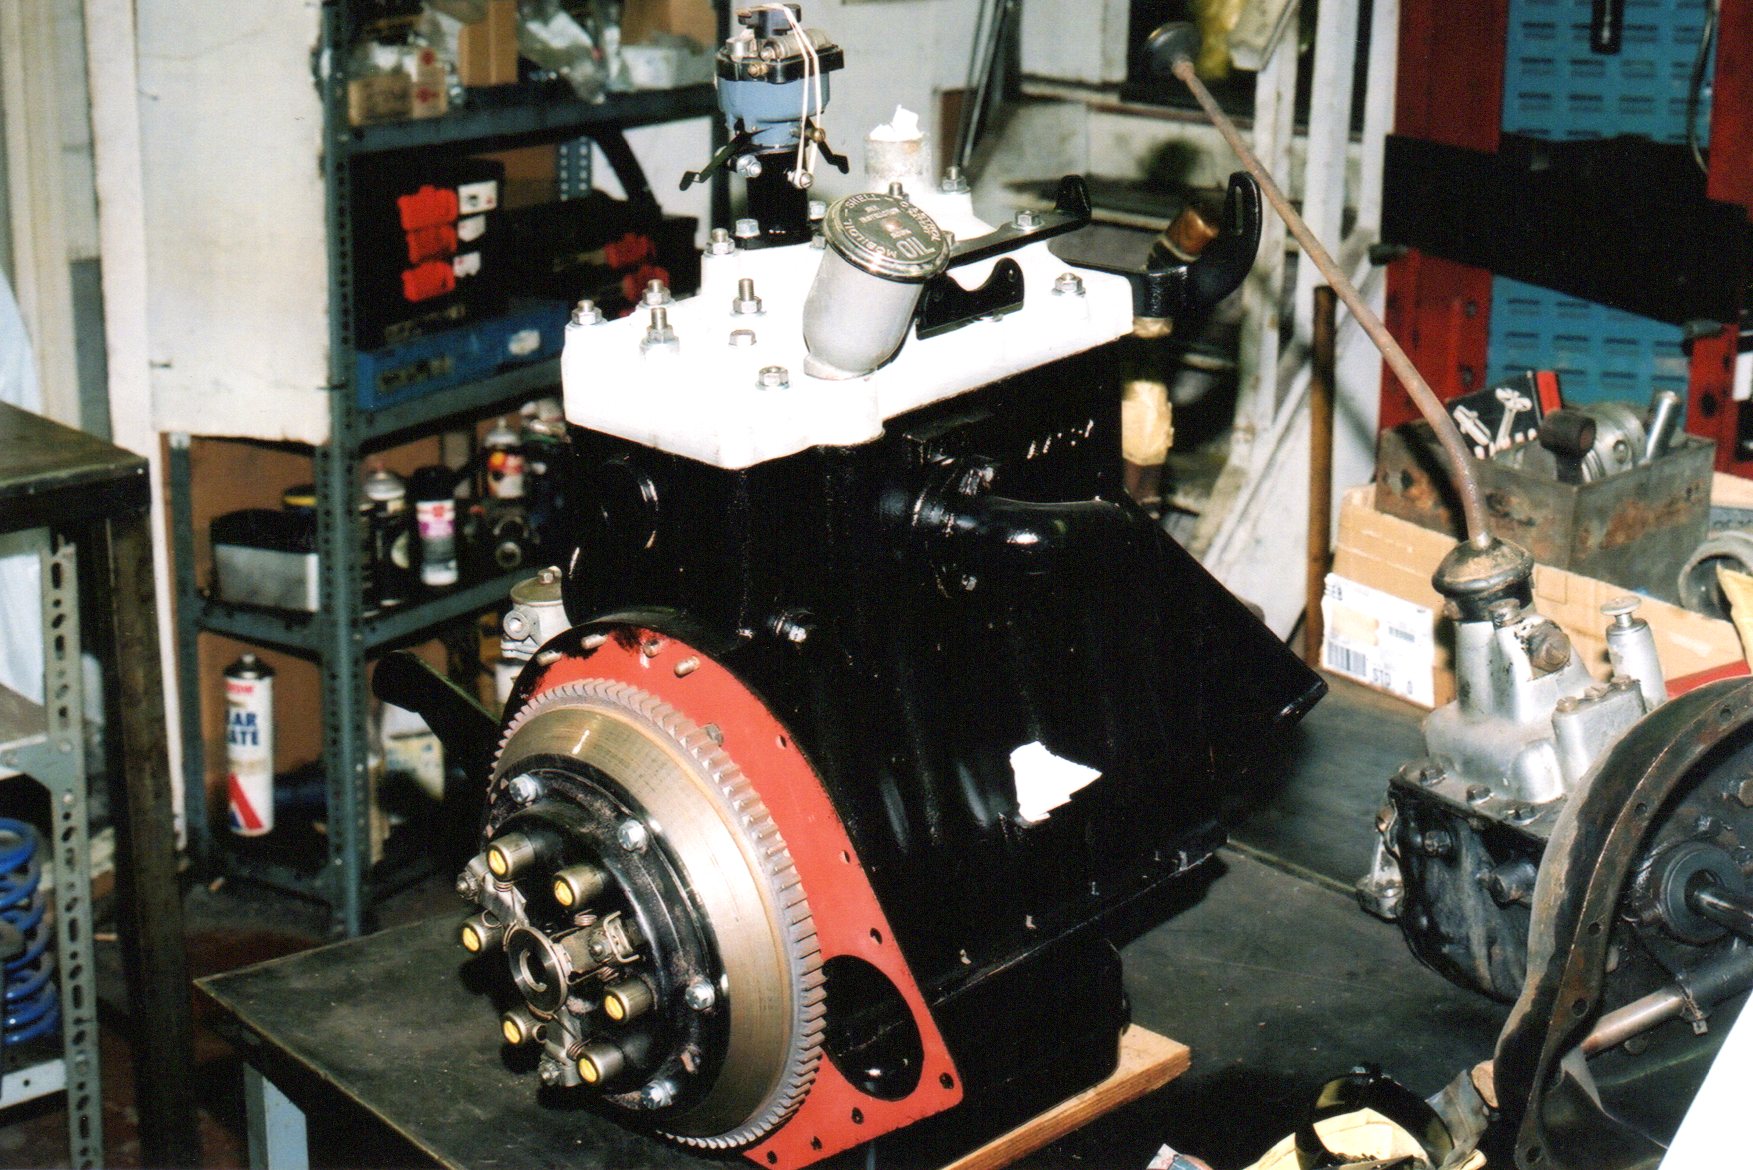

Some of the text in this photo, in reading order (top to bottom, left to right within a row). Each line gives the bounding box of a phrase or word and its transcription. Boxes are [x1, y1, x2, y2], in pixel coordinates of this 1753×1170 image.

[845, 193, 880, 209] SHELL
[843, 218, 898, 258] MOBILOIL
[896, 236, 937, 259] OIL
